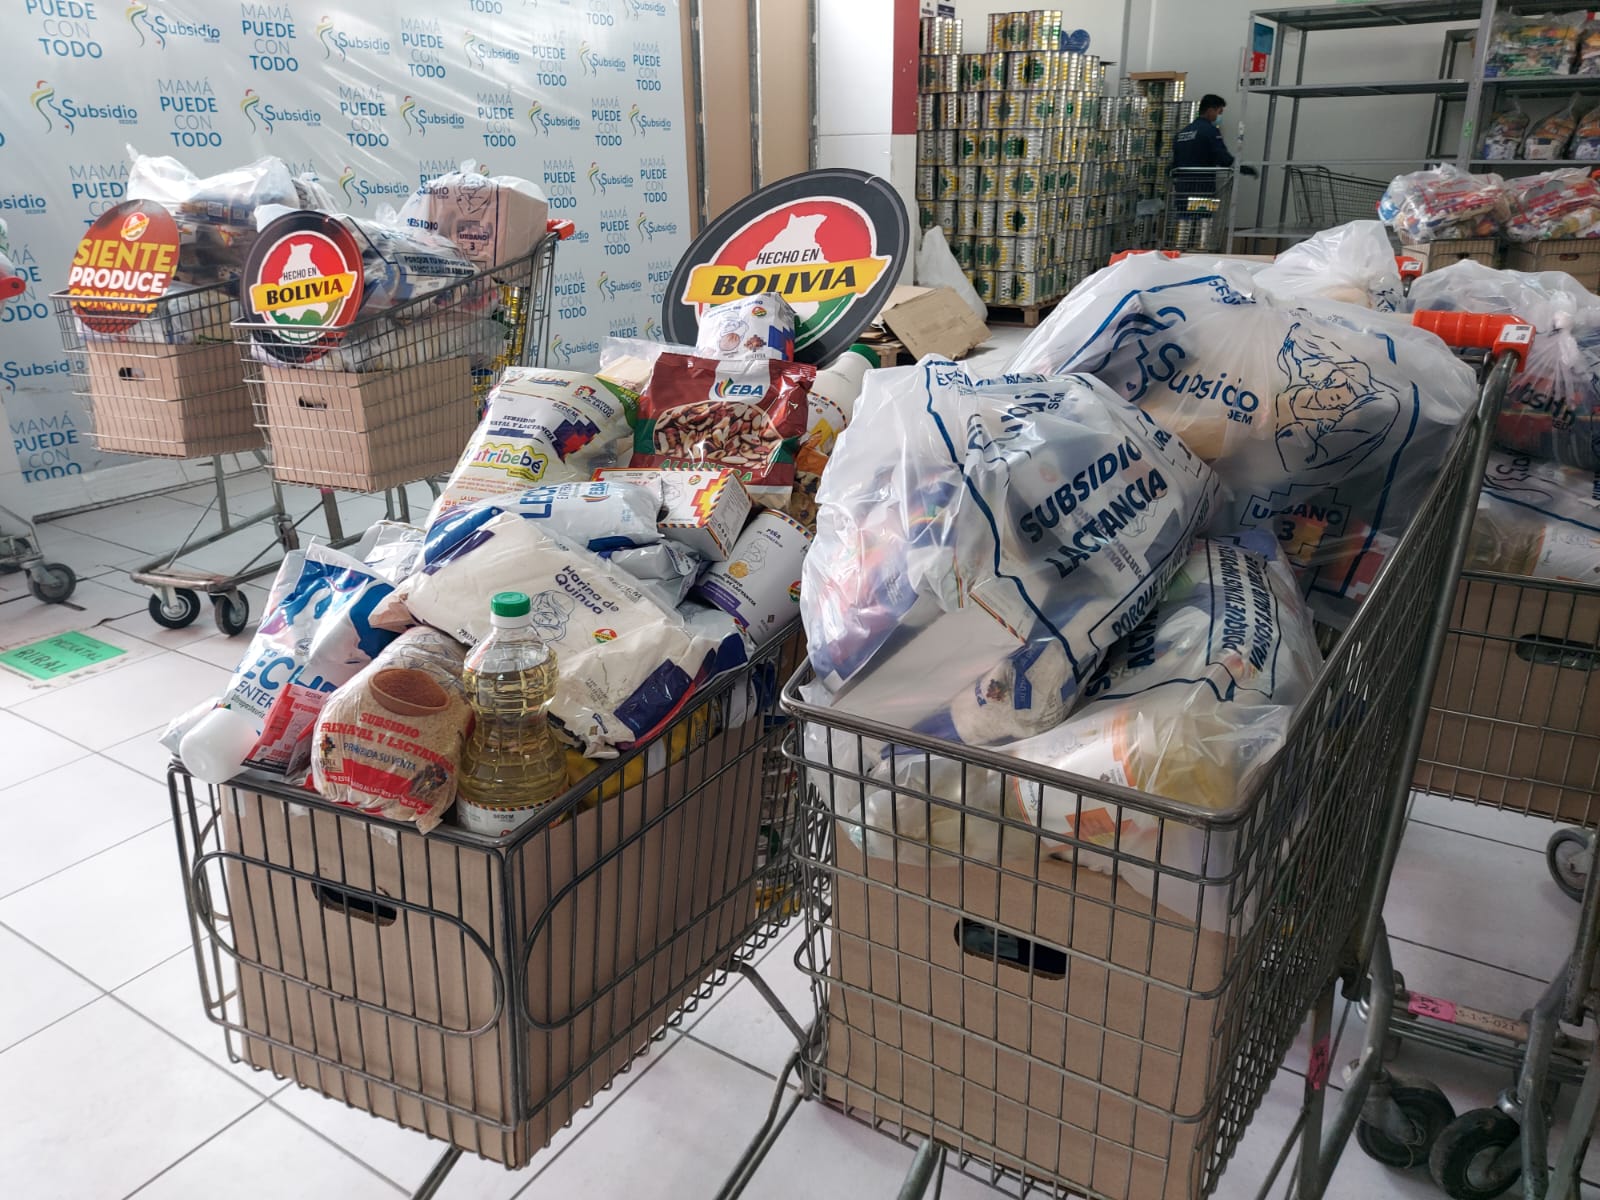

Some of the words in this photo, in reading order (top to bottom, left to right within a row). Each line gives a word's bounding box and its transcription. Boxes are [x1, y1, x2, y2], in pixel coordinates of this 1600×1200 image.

[241, 4, 293, 22] MAMÁ
[470, 0, 503, 14] TODO
[586, 13, 614, 26] TODO
[43, 19, 90, 38] CON
[155, 16, 220, 39] Subsidio
[242, 20, 296, 39] PUEDE
[253, 38, 290, 54] CON
[338, 32, 390, 51] Subsidio
[402, 33, 444, 49] PUEDE
[38, 38, 103, 59] TODO
[478, 44, 519, 60] Subsidio
[532, 46, 566, 60] PUEDE
[411, 49, 440, 63] CON
[592, 53, 626, 68] Subsidio
[633, 54, 661, 67] PUEDE
[249, 55, 298, 72] TODO
[408, 64, 446, 78] TODO
[158, 77, 213, 95] MAMÁ
[537, 73, 567, 87] TODO
[636, 79, 661, 91] TODO
[339, 85, 384, 101] MAMÁ
[477, 88, 512, 105] MAMÁ
[61, 99, 137, 120] Subsidio
[160, 96, 218, 113] PUEDE
[340, 102, 387, 117] PUEDE
[592, 96, 619, 109] MAMÁ
[264, 105, 321, 122] Subsidio
[419, 109, 464, 125] Subsidio
[478, 107, 514, 120] PUEDE
[543, 113, 580, 127] Subsidio
[592, 110, 621, 121] PUEDE
[174, 114, 212, 131] CON
[352, 119, 382, 132] CON
[487, 121, 510, 134] CON
[597, 122, 618, 134] CON
[641, 115, 671, 128] Subsidio
[170, 132, 222, 148] TODO
[346, 133, 389, 147] TODO
[483, 135, 516, 147] TODO
[595, 135, 622, 146] TODO
[543, 156, 574, 170] MAMÁ
[640, 156, 665, 167] MAMÁ
[544, 172, 576, 183] PUEDE
[602, 173, 633, 186] Subsidio
[640, 168, 667, 179] PUEDE
[360, 179, 409, 195] Subsidio
[551, 184, 572, 196] CON
[646, 180, 664, 191] CON
[548, 196, 577, 208] TODO
[644, 191, 667, 203] TODO
[600, 206, 628, 219] MAMÁ
[600, 220, 629, 232] PUEDE
[648, 222, 677, 234] Subsidio
[606, 232, 626, 243] CON
[470, 242, 475, 250] 3
[604, 244, 630, 256] TODO
[756, 251, 798, 265] HECHO
[802, 248, 820, 261] EN
[283, 271, 306, 281] HECHO
[307, 267, 317, 277] EN
[554, 267, 584, 283] MAMÁ
[711, 265, 857, 296] BOLIVIA
[68, 267, 168, 297] PRODUCE,
[610, 280, 642, 293] Subsidio
[266, 278, 343, 306] BOLIVIA
[554, 283, 586, 296] PUEDE
[561, 295, 582, 307] CON
[558, 306, 587, 320] TODO
[609, 313, 636, 327] MAMÁ
[610, 327, 638, 337] PUEDE
[565, 341, 599, 355] Subsidio
[729, 385, 764, 396] EBA
[14, 430, 79, 454] PUEDE
[28, 449, 70, 469] CON
[1020, 435, 1143, 544] SUBSIDIO
[1044, 467, 1168, 578] LACTANCIA
[1278, 521, 1296, 541] 3
[555, 573, 604, 615] Quinua
[562, 565, 602, 602] Harina
[602, 599, 620, 613] de
[1111, 582, 1158, 637] PORQUE
[1222, 602, 1250, 655] PORQUE
[1249, 622, 1274, 672] VAMOS
[13, 650, 68, 673] RURAL
[359, 712, 420, 739] SUBSIDIO
[376, 732, 385, 744] Y
[379, 753, 391, 764] SU
[391, 755, 417, 772] VENTA
[1418, 1004, 1440, 1014] 26
